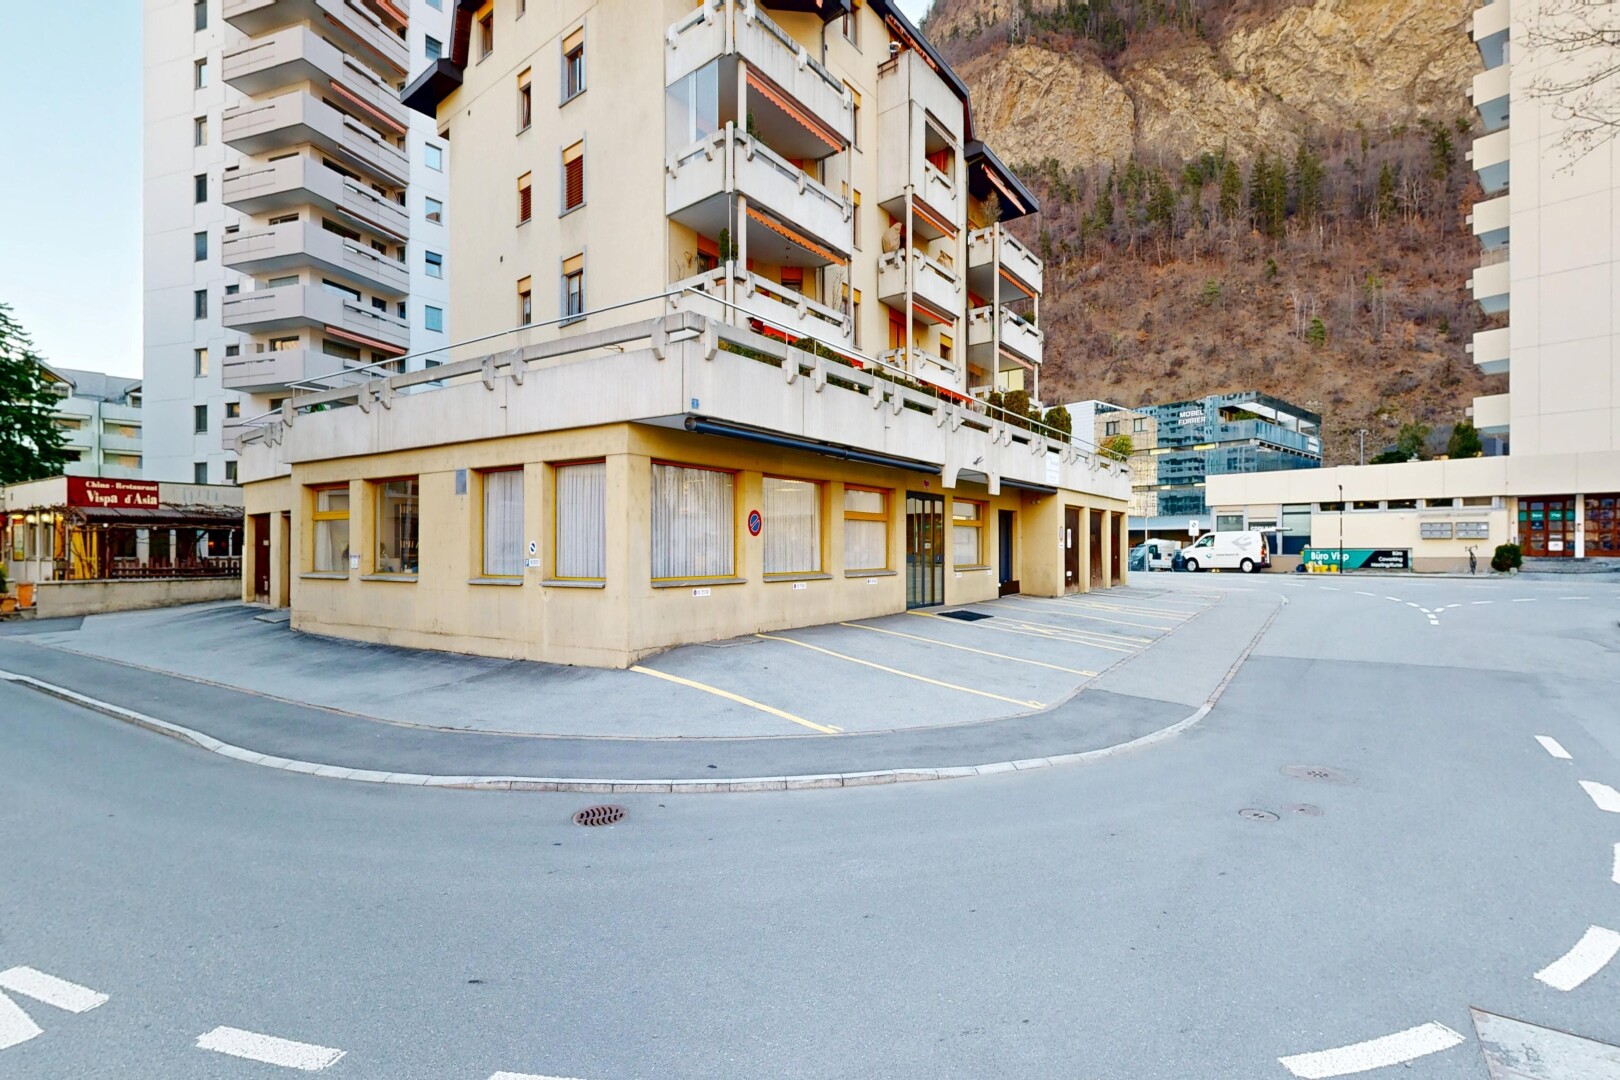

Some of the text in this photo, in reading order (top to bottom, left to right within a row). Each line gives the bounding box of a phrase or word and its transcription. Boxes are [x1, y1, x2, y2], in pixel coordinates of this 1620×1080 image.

[85, 480, 110, 489] China
[115, 482, 157, 491] Restaurant
[86, 490, 118, 506] Vispa
[1311, 551, 1329, 560] Büro
